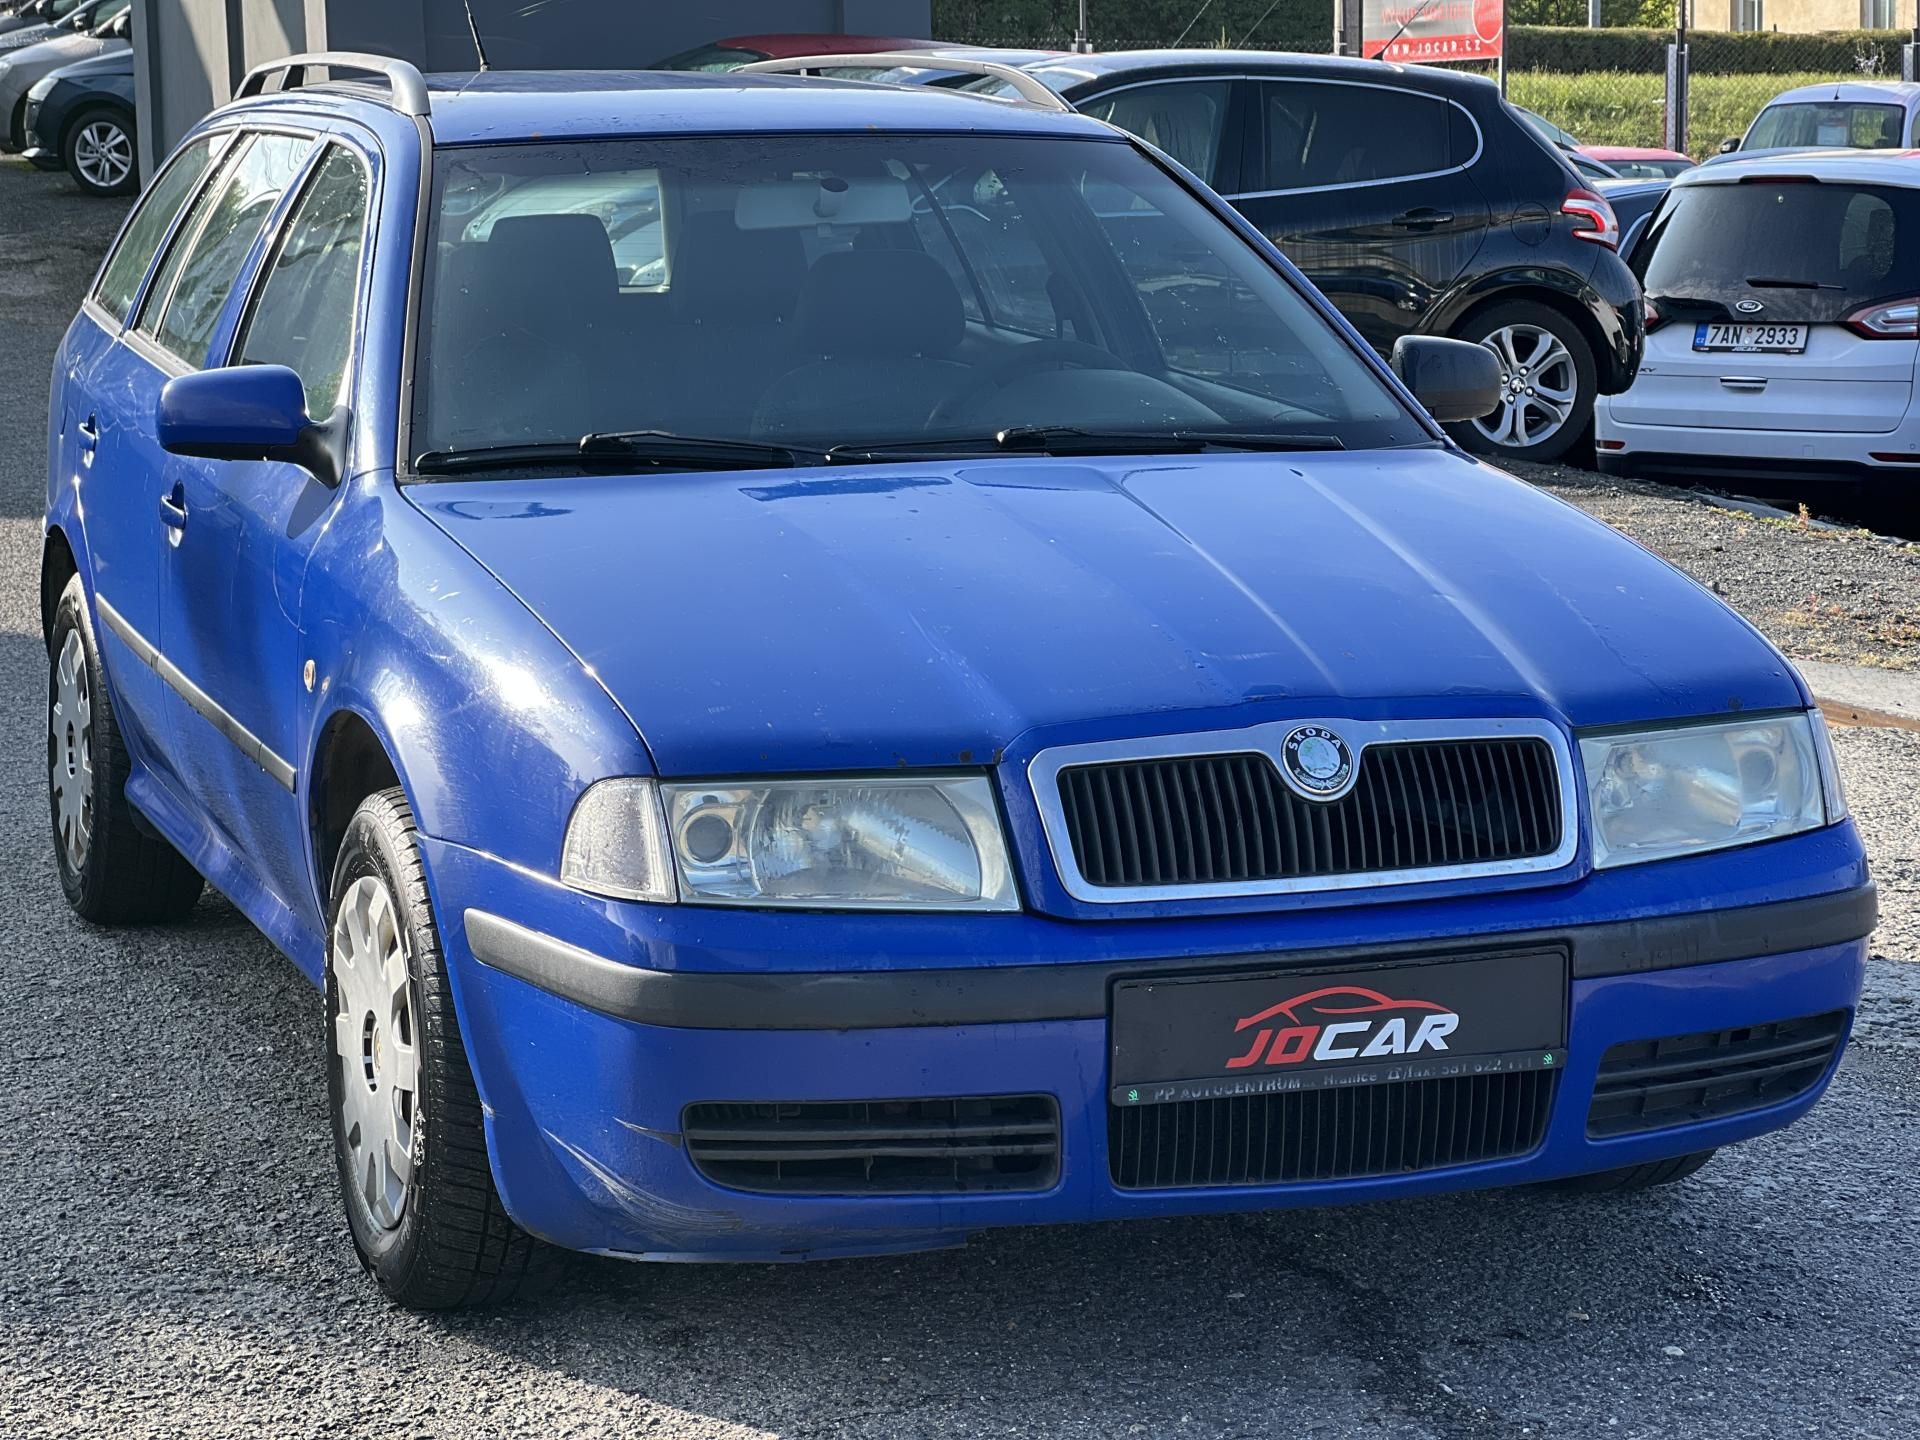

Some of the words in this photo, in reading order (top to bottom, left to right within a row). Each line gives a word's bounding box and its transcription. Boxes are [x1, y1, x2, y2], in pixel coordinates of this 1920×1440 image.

[1710, 326, 1742, 344] 7AN
[1754, 327, 1798, 345] 2933
[1225, 1013, 1459, 1068] JOCAR
